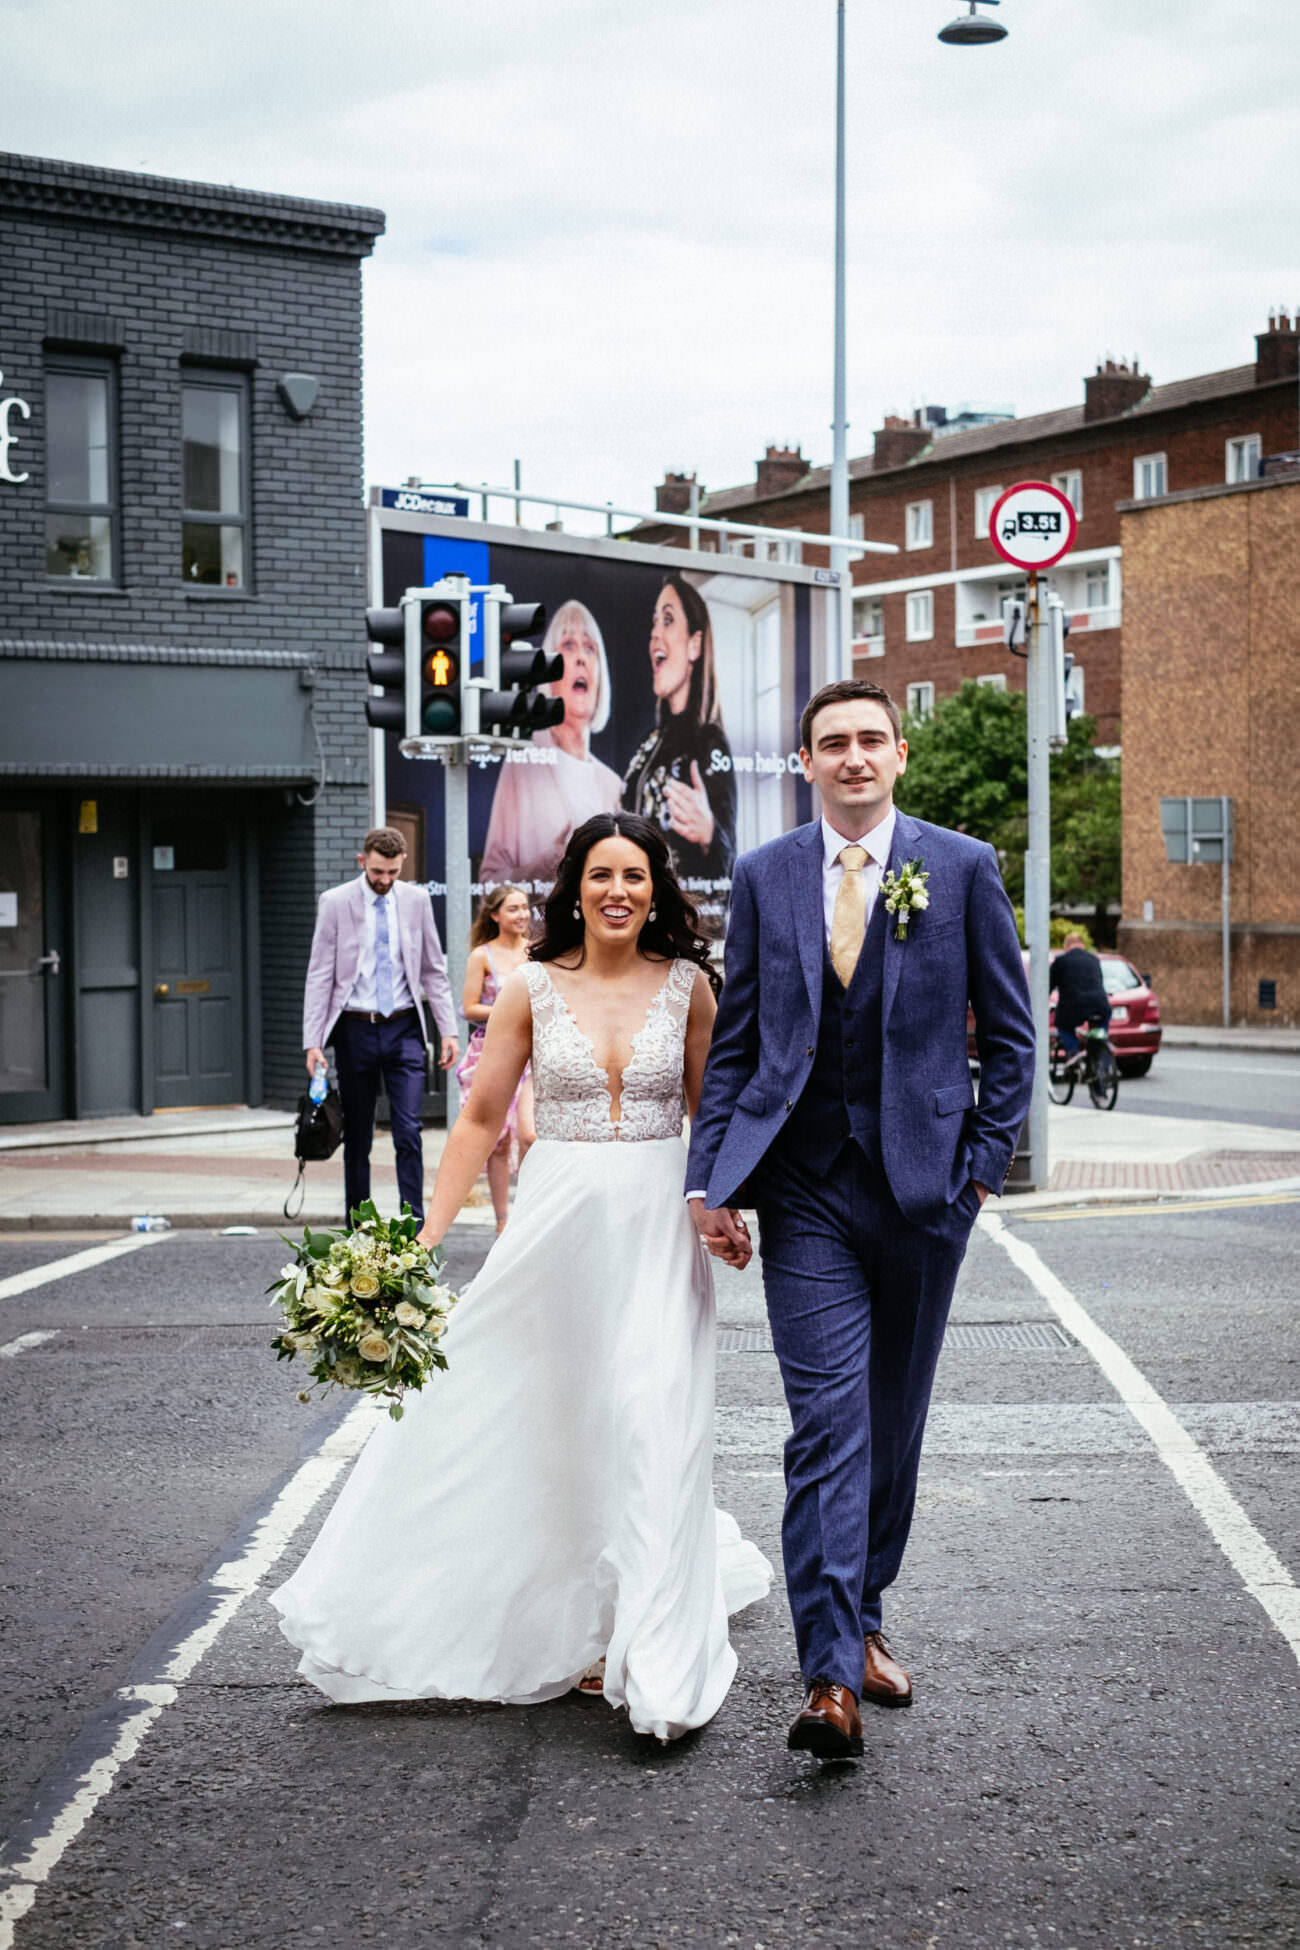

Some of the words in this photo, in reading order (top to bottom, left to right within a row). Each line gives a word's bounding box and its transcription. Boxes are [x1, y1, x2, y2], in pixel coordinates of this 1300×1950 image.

[394, 493, 457, 515] JCDecaux
[1021, 514, 1057, 531] 3.5t
[710, 748, 731, 773] So
[732, 754, 754, 774] we
[755, 750, 787, 780] help
